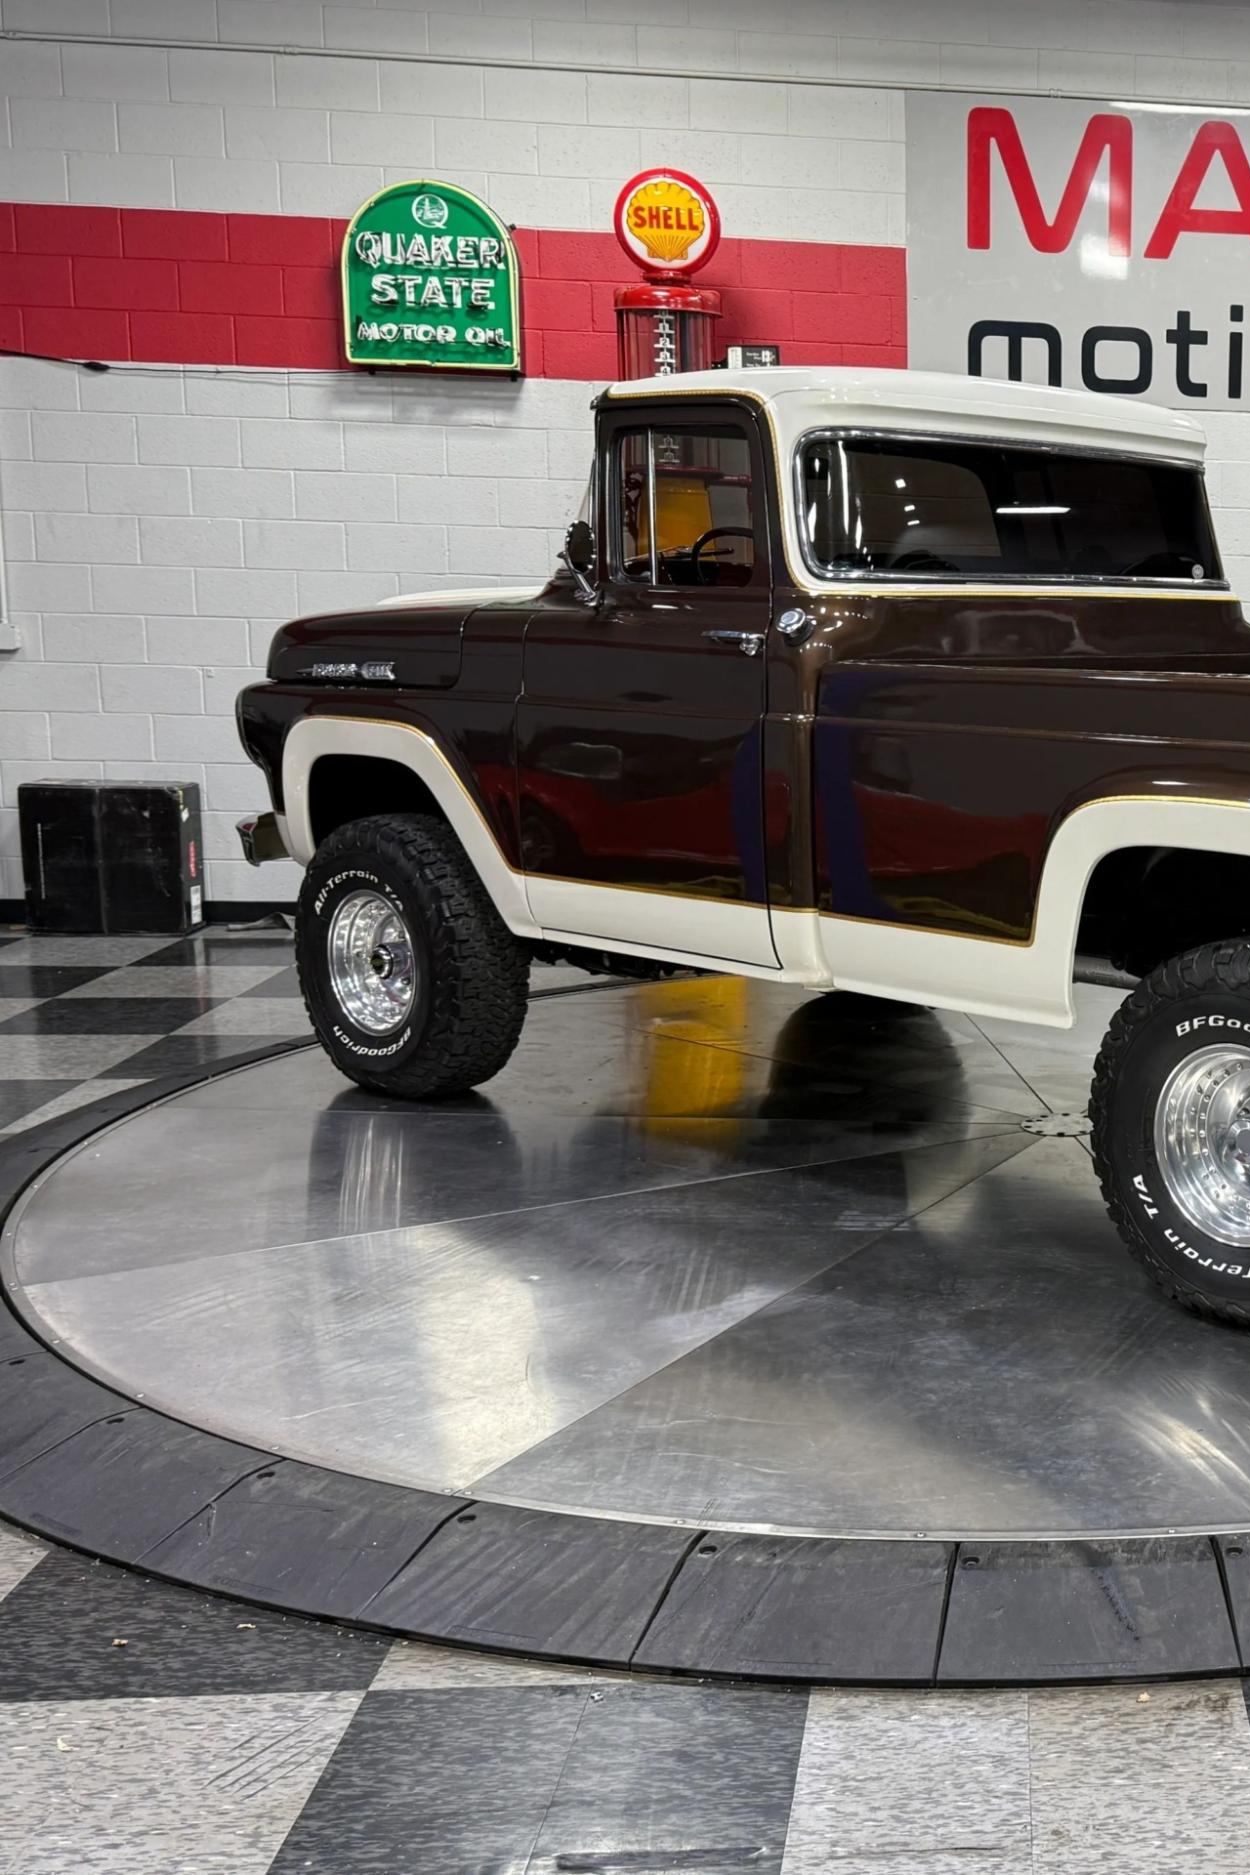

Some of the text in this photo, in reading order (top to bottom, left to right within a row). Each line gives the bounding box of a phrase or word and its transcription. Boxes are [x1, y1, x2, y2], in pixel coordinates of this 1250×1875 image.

[633, 205, 700, 232] SHELL
[355, 231, 506, 269] QUAKER
[371, 274, 496, 309] STATE
[357, 321, 511, 347] MOTOR OIL
[314, 869, 379, 915] All-Terrain
[333, 1025, 412, 1056] BFGoodrich
[1132, 1174, 1159, 1219] T/A
